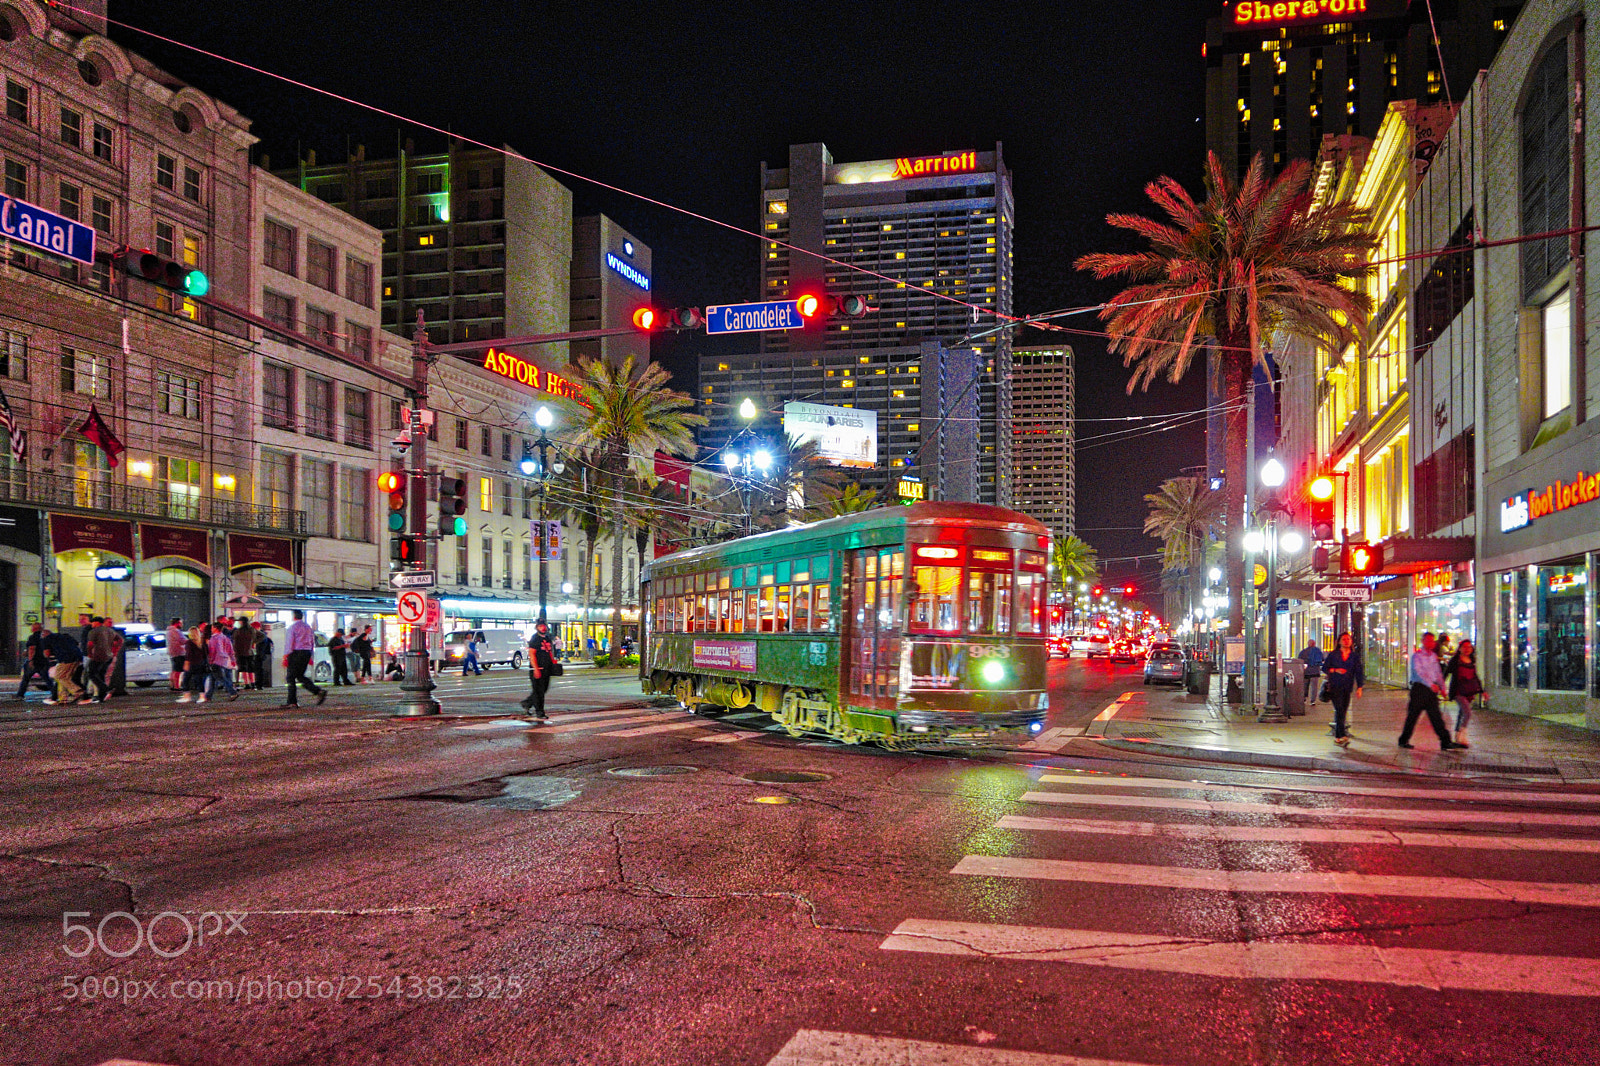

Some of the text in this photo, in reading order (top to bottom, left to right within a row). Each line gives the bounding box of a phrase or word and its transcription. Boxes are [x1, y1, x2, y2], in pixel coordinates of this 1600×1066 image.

[892, 152, 976, 178] Marriott
[1, 199, 74, 255] Canal
[607, 252, 649, 291] WYNDHAM
[724, 304, 792, 331] Carondelet
[484, 348, 540, 388] ASTOR
[798, 413, 864, 428] BOUNARIES
[899, 481, 923, 499] PALACE
[1555, 471, 1600, 511] Locker
[402, 575, 429, 584] ONE WAY
[1331, 588, 1366, 596] ONE WAY
[809, 654, 827, 667] 963
[969, 644, 1011, 659] 963
